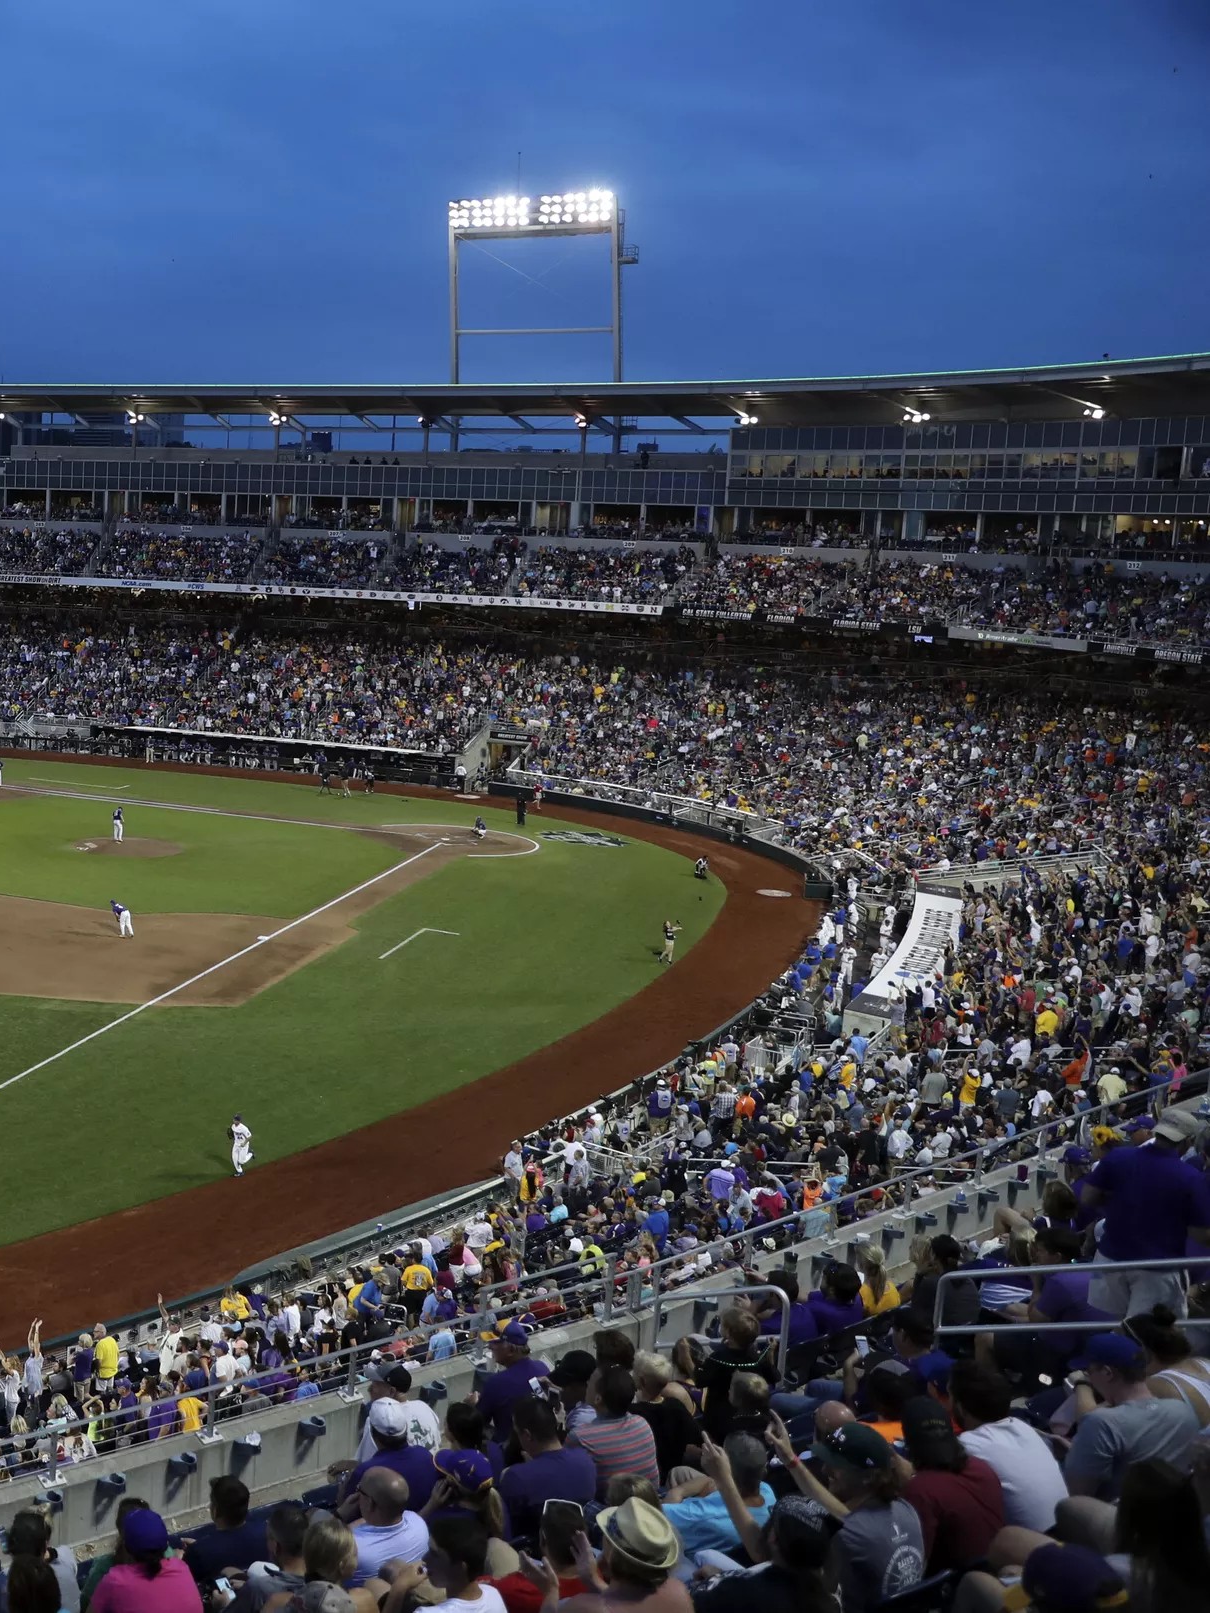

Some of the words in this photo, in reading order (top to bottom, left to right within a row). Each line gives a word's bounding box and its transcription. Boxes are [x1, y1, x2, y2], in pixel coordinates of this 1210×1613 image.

[682, 608, 694, 616] CAL
[695, 610, 714, 618] STATE
[715, 610, 752, 620] FULLERTON
[766, 614, 795, 624] FLORIDA
[832, 619, 860, 628] FLORIDA
[860, 622, 880, 630] STATE
[908, 625, 922, 634] LSU
[1103, 644, 1136, 656] LOUISVILLE
[1154, 650, 1180, 661] OREGON
[1182, 653, 1202, 664] STATE
[900, 946, 940, 974] COLLEGE
[922, 908, 953, 930] SERIES
